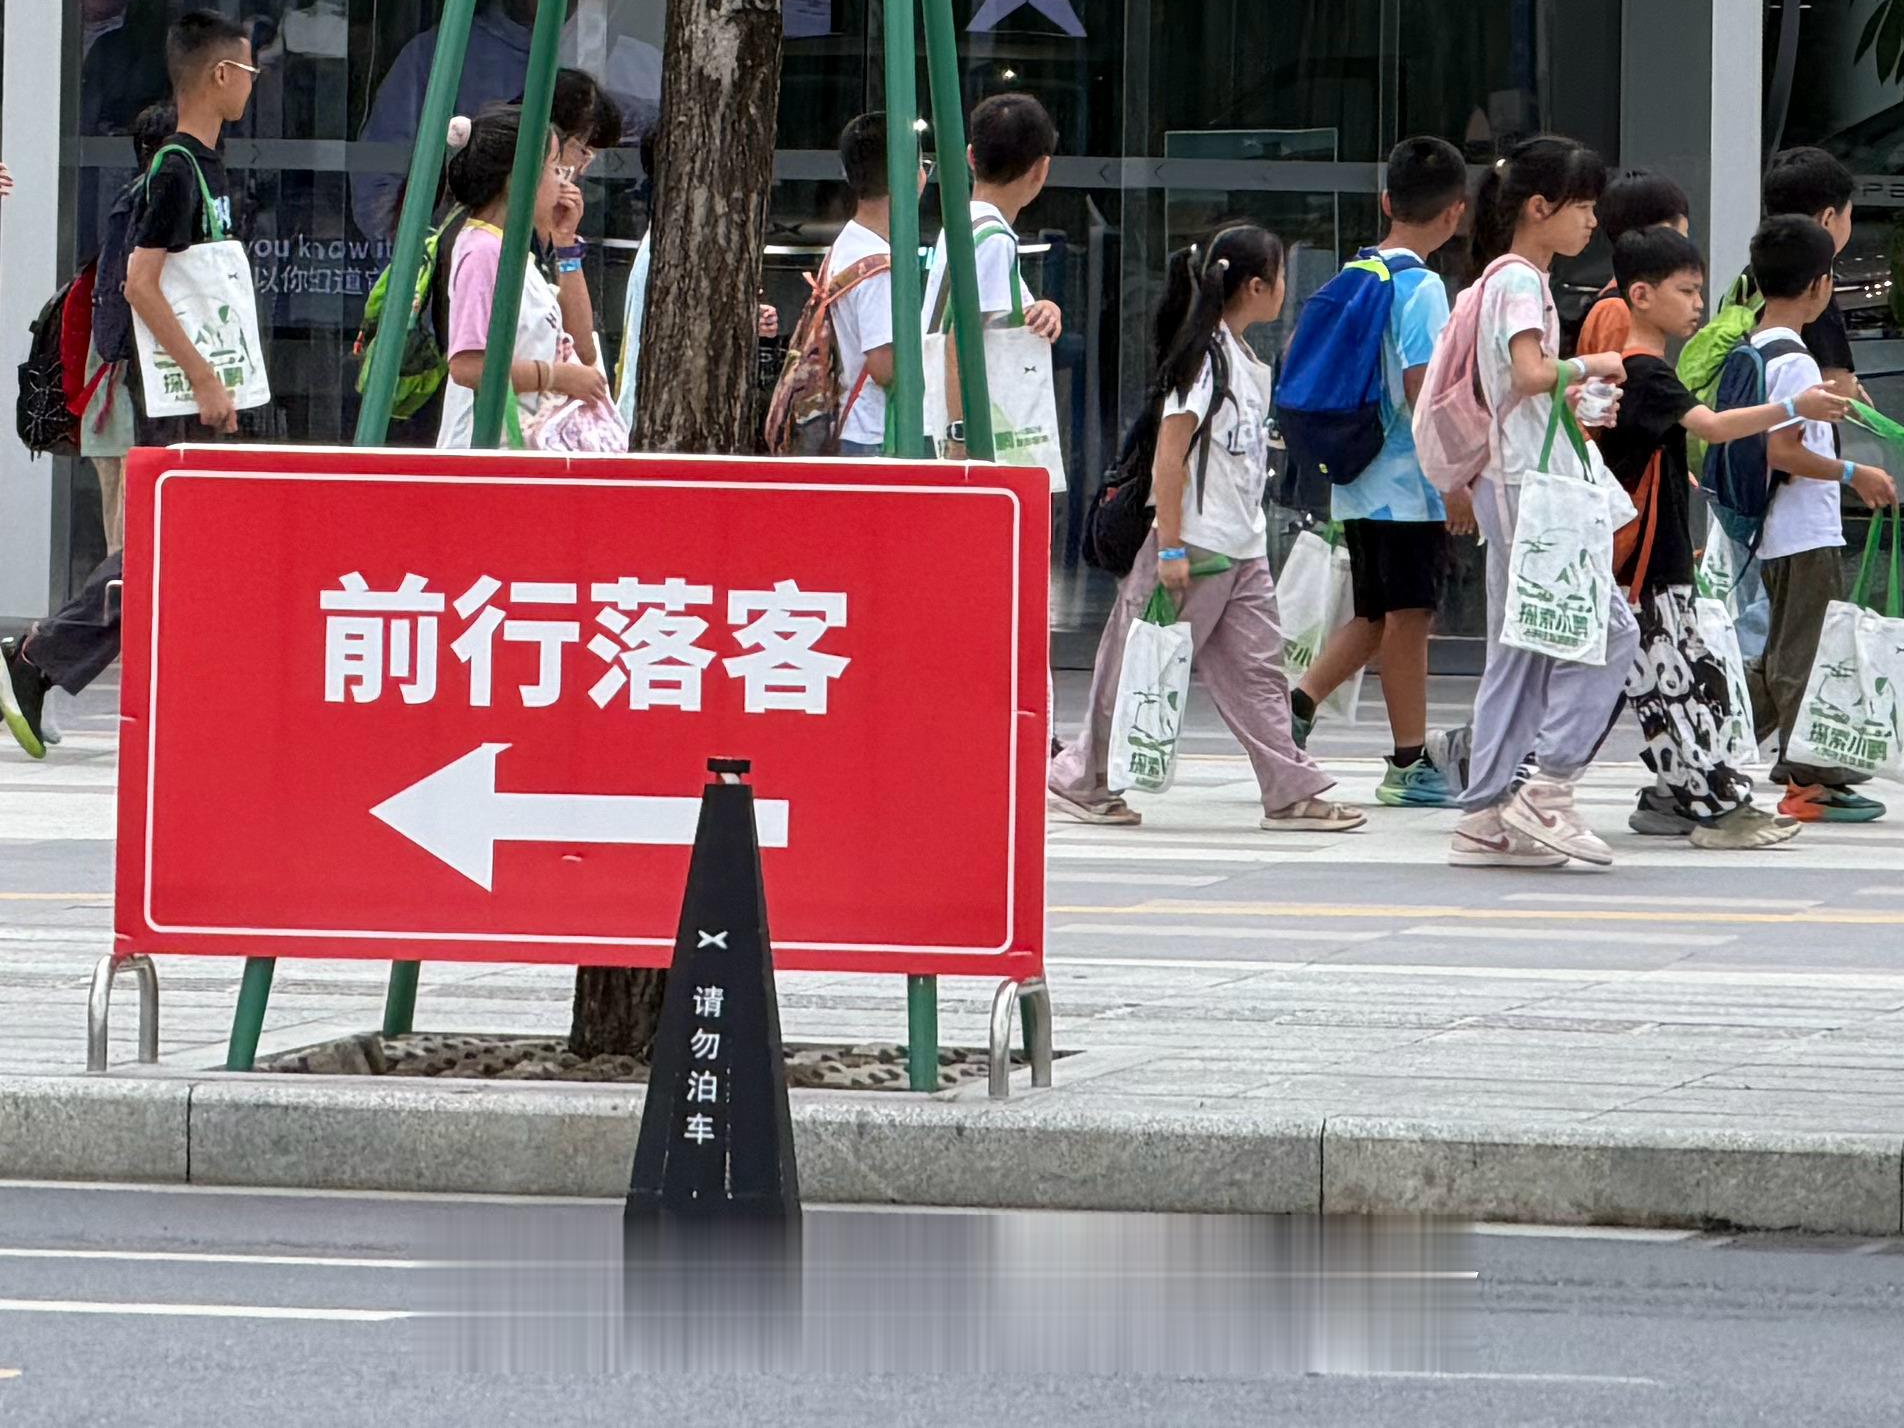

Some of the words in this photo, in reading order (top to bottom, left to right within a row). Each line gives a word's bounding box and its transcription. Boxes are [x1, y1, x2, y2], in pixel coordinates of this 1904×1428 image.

[318, 571, 852, 716] 前行落客
[683, 985, 725, 1145] 请勿泊车
